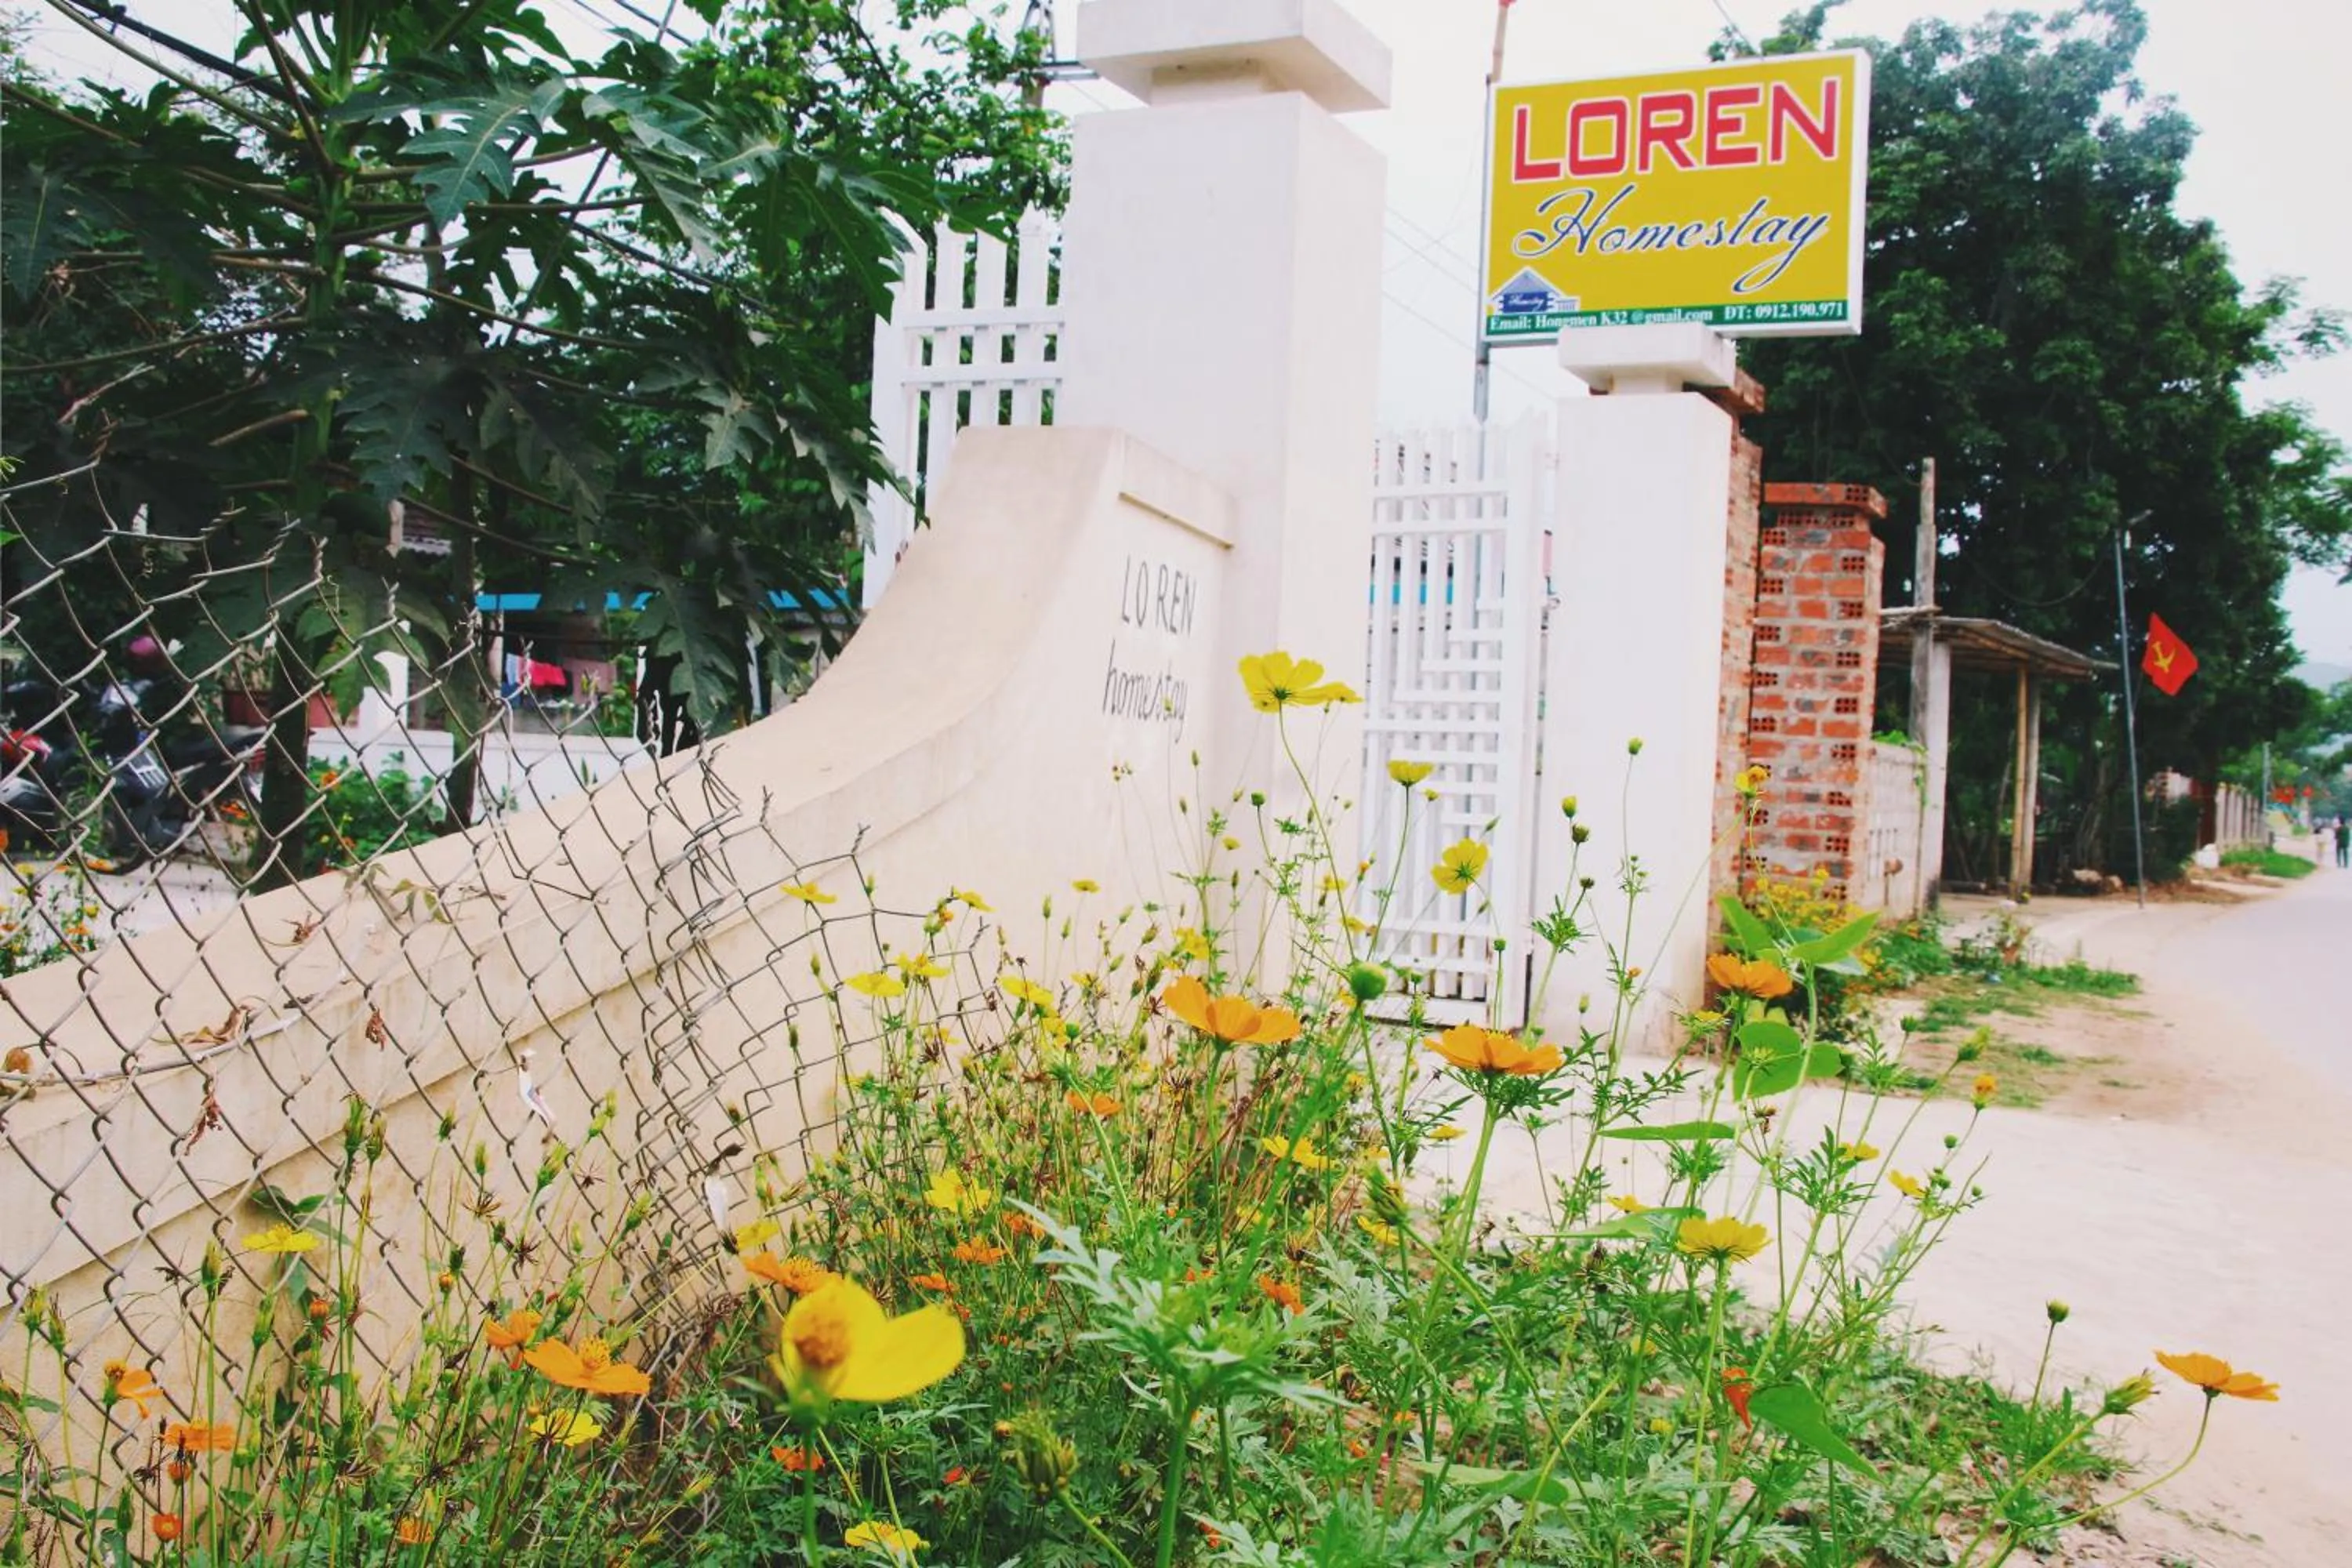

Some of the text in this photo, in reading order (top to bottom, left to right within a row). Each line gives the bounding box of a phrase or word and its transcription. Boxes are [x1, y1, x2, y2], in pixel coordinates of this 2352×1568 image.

[1512, 77, 1841, 183] LOREN
[1512, 184, 1831, 294] Homestay
[1490, 314, 1531, 329] Email:
[1601, 311, 1628, 325] K32
[1755, 303, 1843, 318] 0912.190.971
[1121, 554, 1196, 637] LOREN
[1102, 637, 1188, 746] homestay
